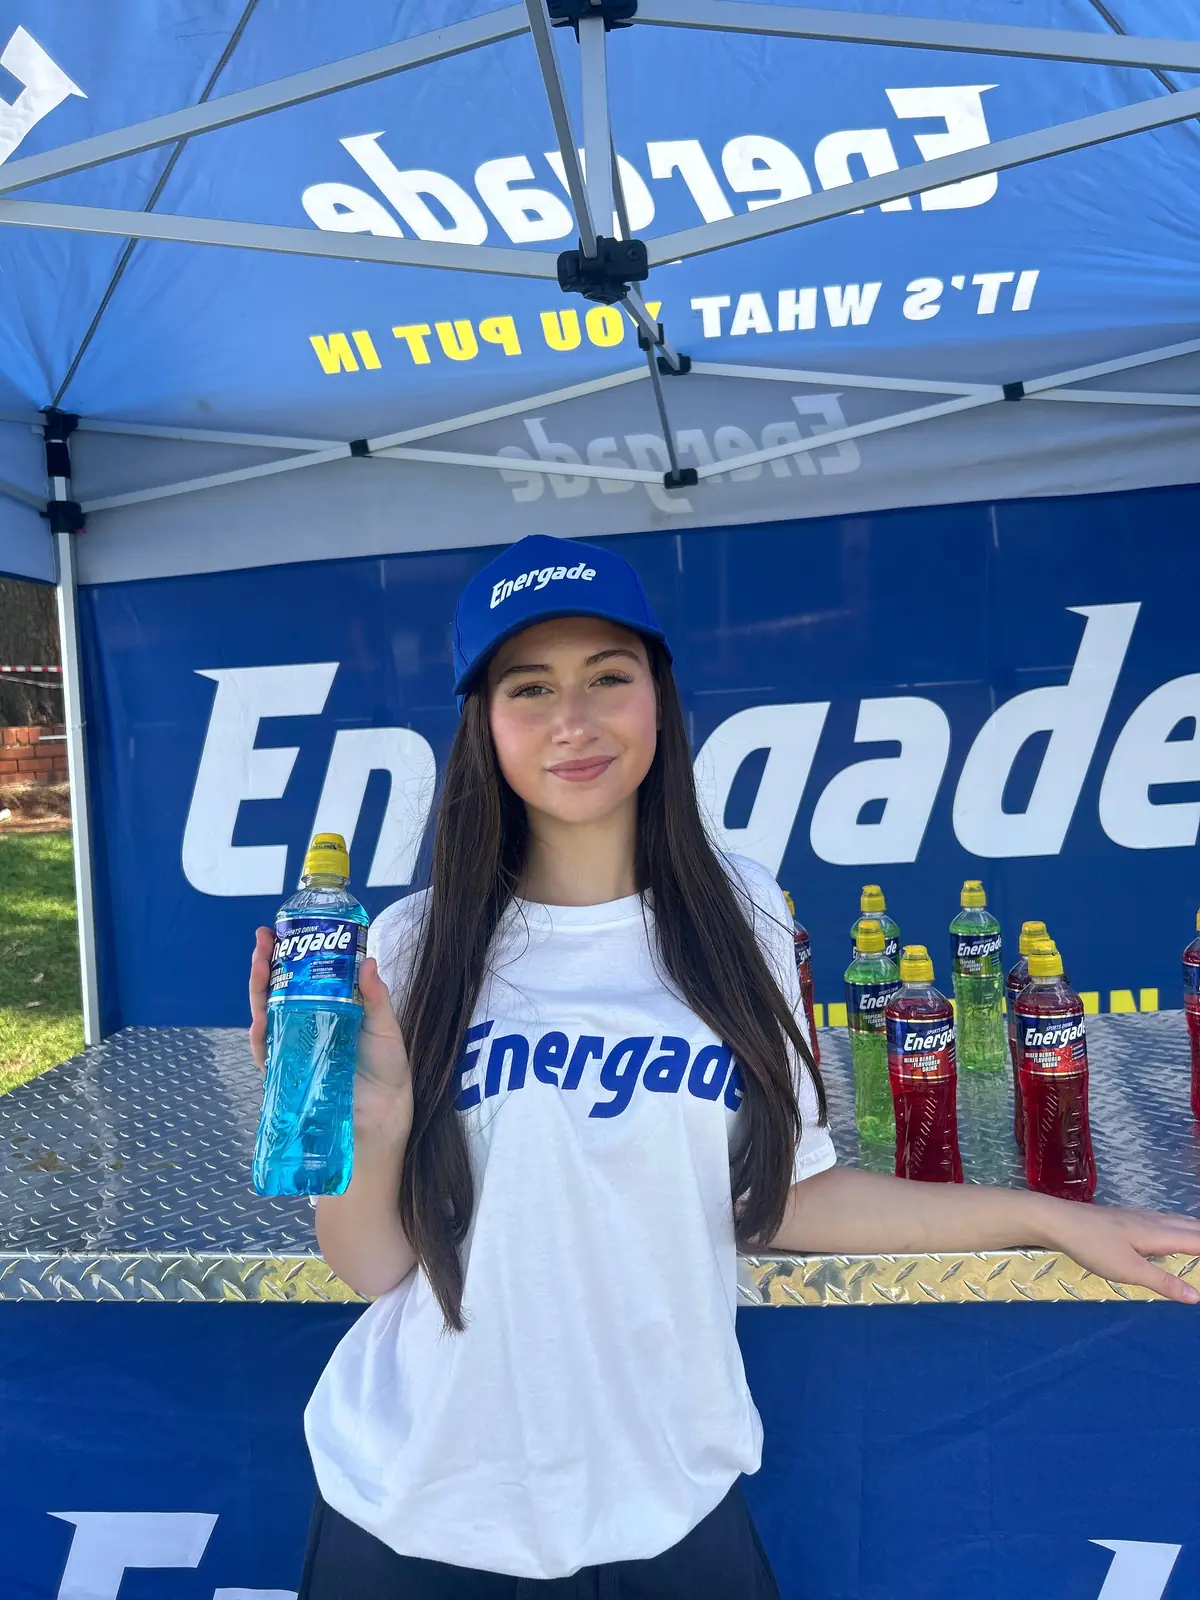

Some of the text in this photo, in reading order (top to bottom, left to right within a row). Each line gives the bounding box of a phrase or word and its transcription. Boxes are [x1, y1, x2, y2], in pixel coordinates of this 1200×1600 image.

[489, 562, 597, 610] Energade
[182, 602, 1200, 897] Engade
[271, 924, 352, 964] nergade
[301, 925, 319, 934] DRINK
[860, 992, 897, 1009] Ener
